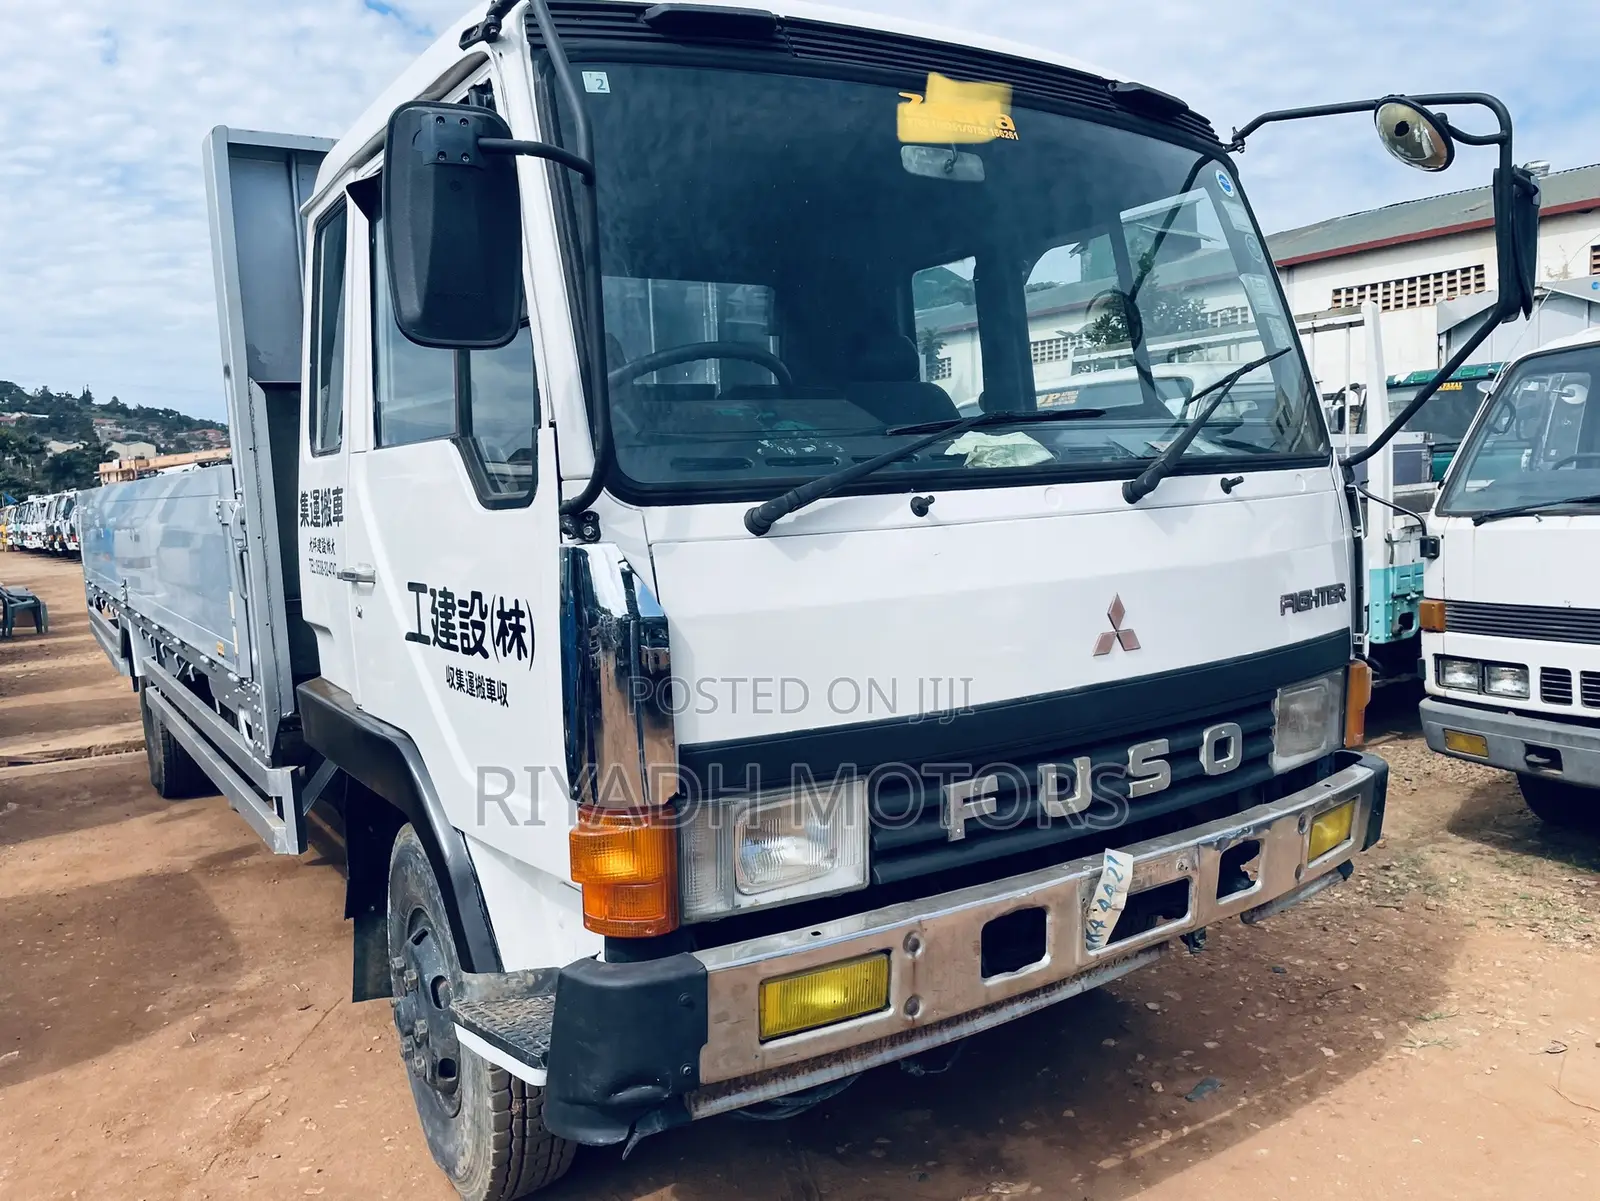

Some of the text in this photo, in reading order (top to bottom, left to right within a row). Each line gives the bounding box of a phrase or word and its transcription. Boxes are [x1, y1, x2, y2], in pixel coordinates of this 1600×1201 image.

[405, 581, 535, 671] 工建設(株)
[1280, 582, 1347, 616] FIGHTER
[943, 722, 1243, 842] FUSO
